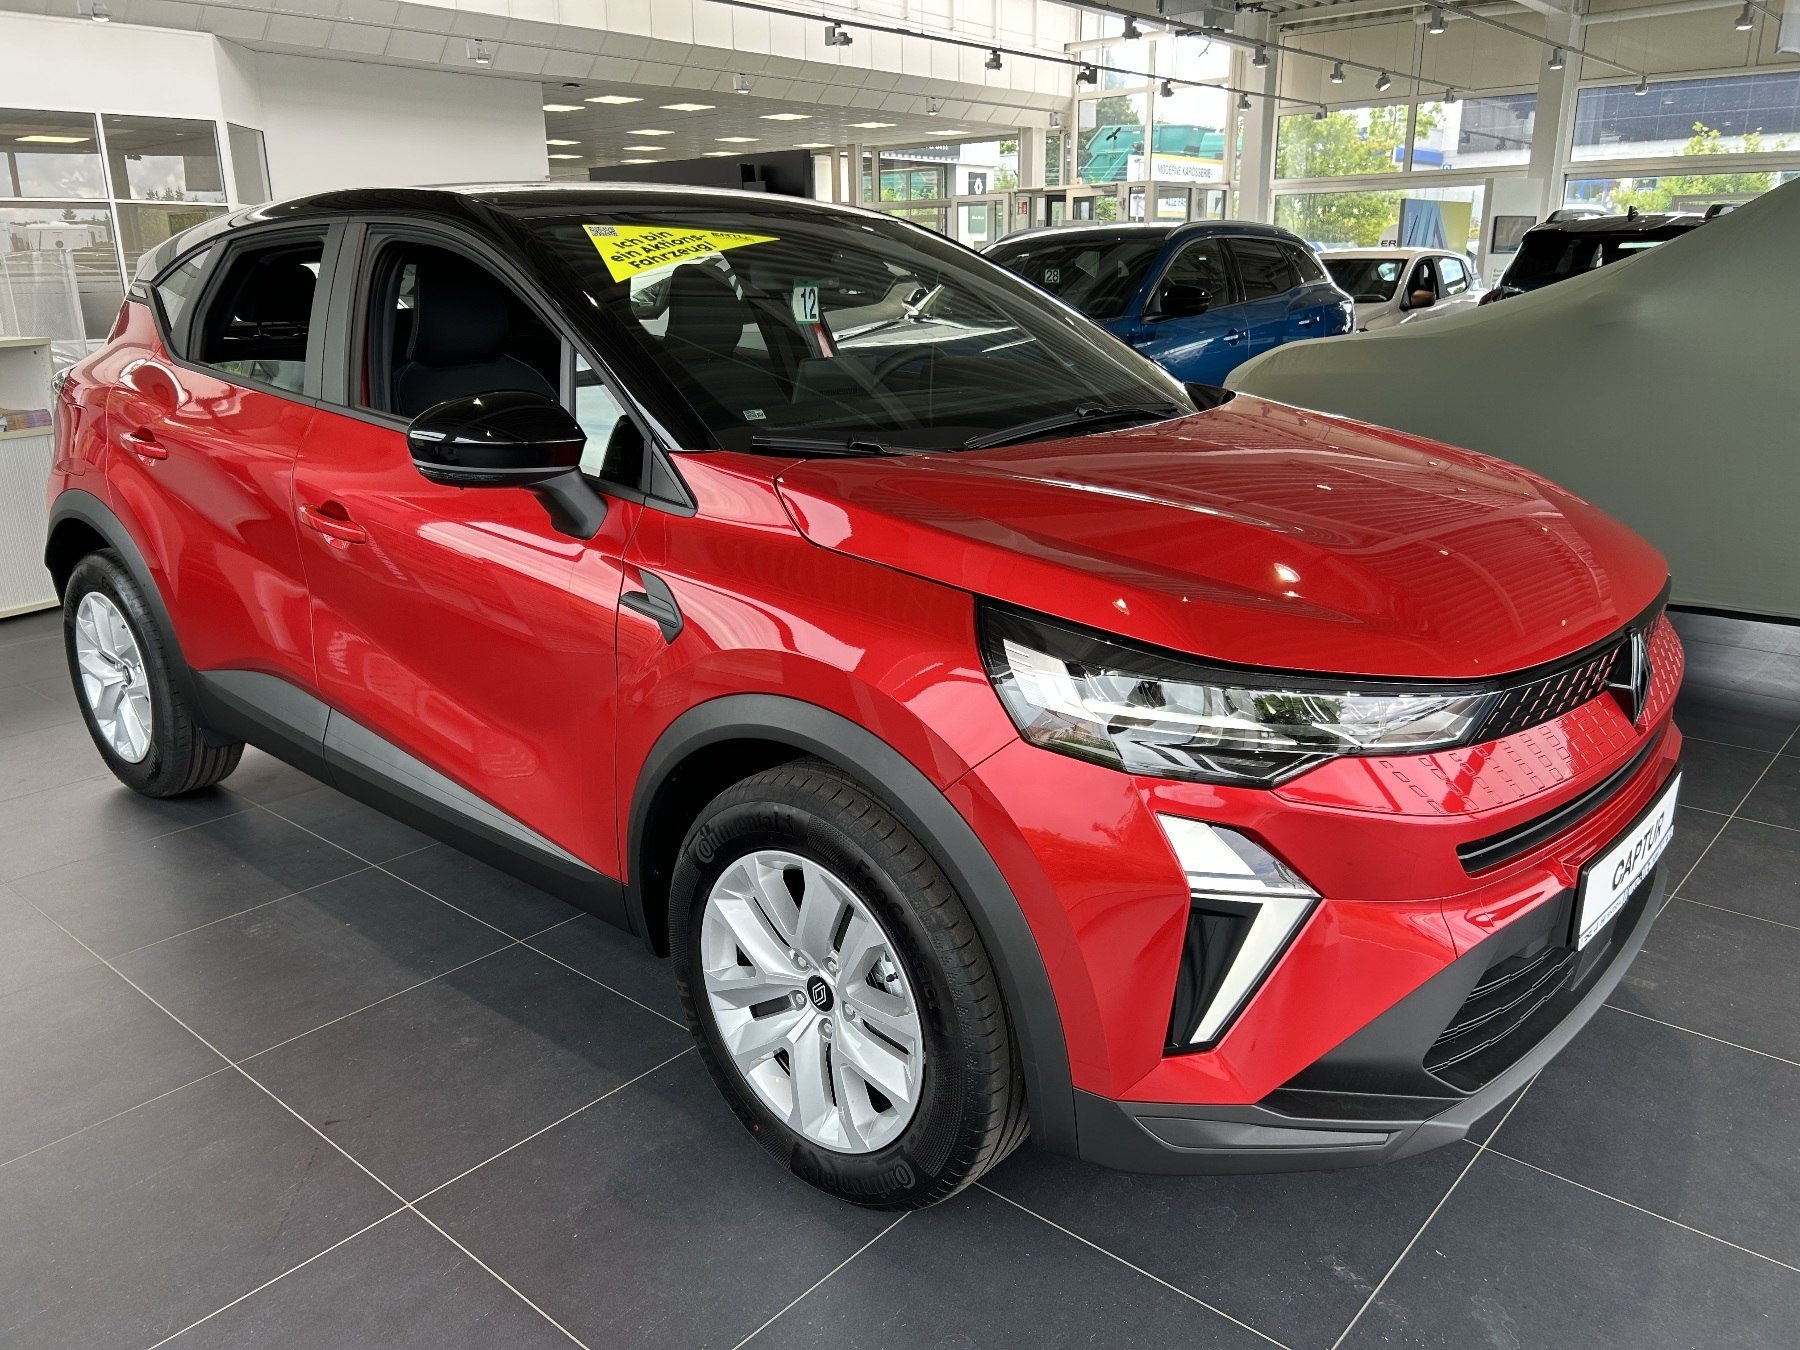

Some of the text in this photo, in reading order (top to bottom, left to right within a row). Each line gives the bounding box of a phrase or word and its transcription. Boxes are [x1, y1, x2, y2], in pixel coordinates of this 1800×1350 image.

[610, 250, 642, 262] ein
[640, 235, 707, 254] Aktions-
[612, 232, 674, 249] Ich bin
[628, 241, 717, 269] Fahrzeug!
[1046, 270, 1059, 283] 28
[801, 288, 817, 319] 12
[1612, 810, 1665, 891] CAPTUR
